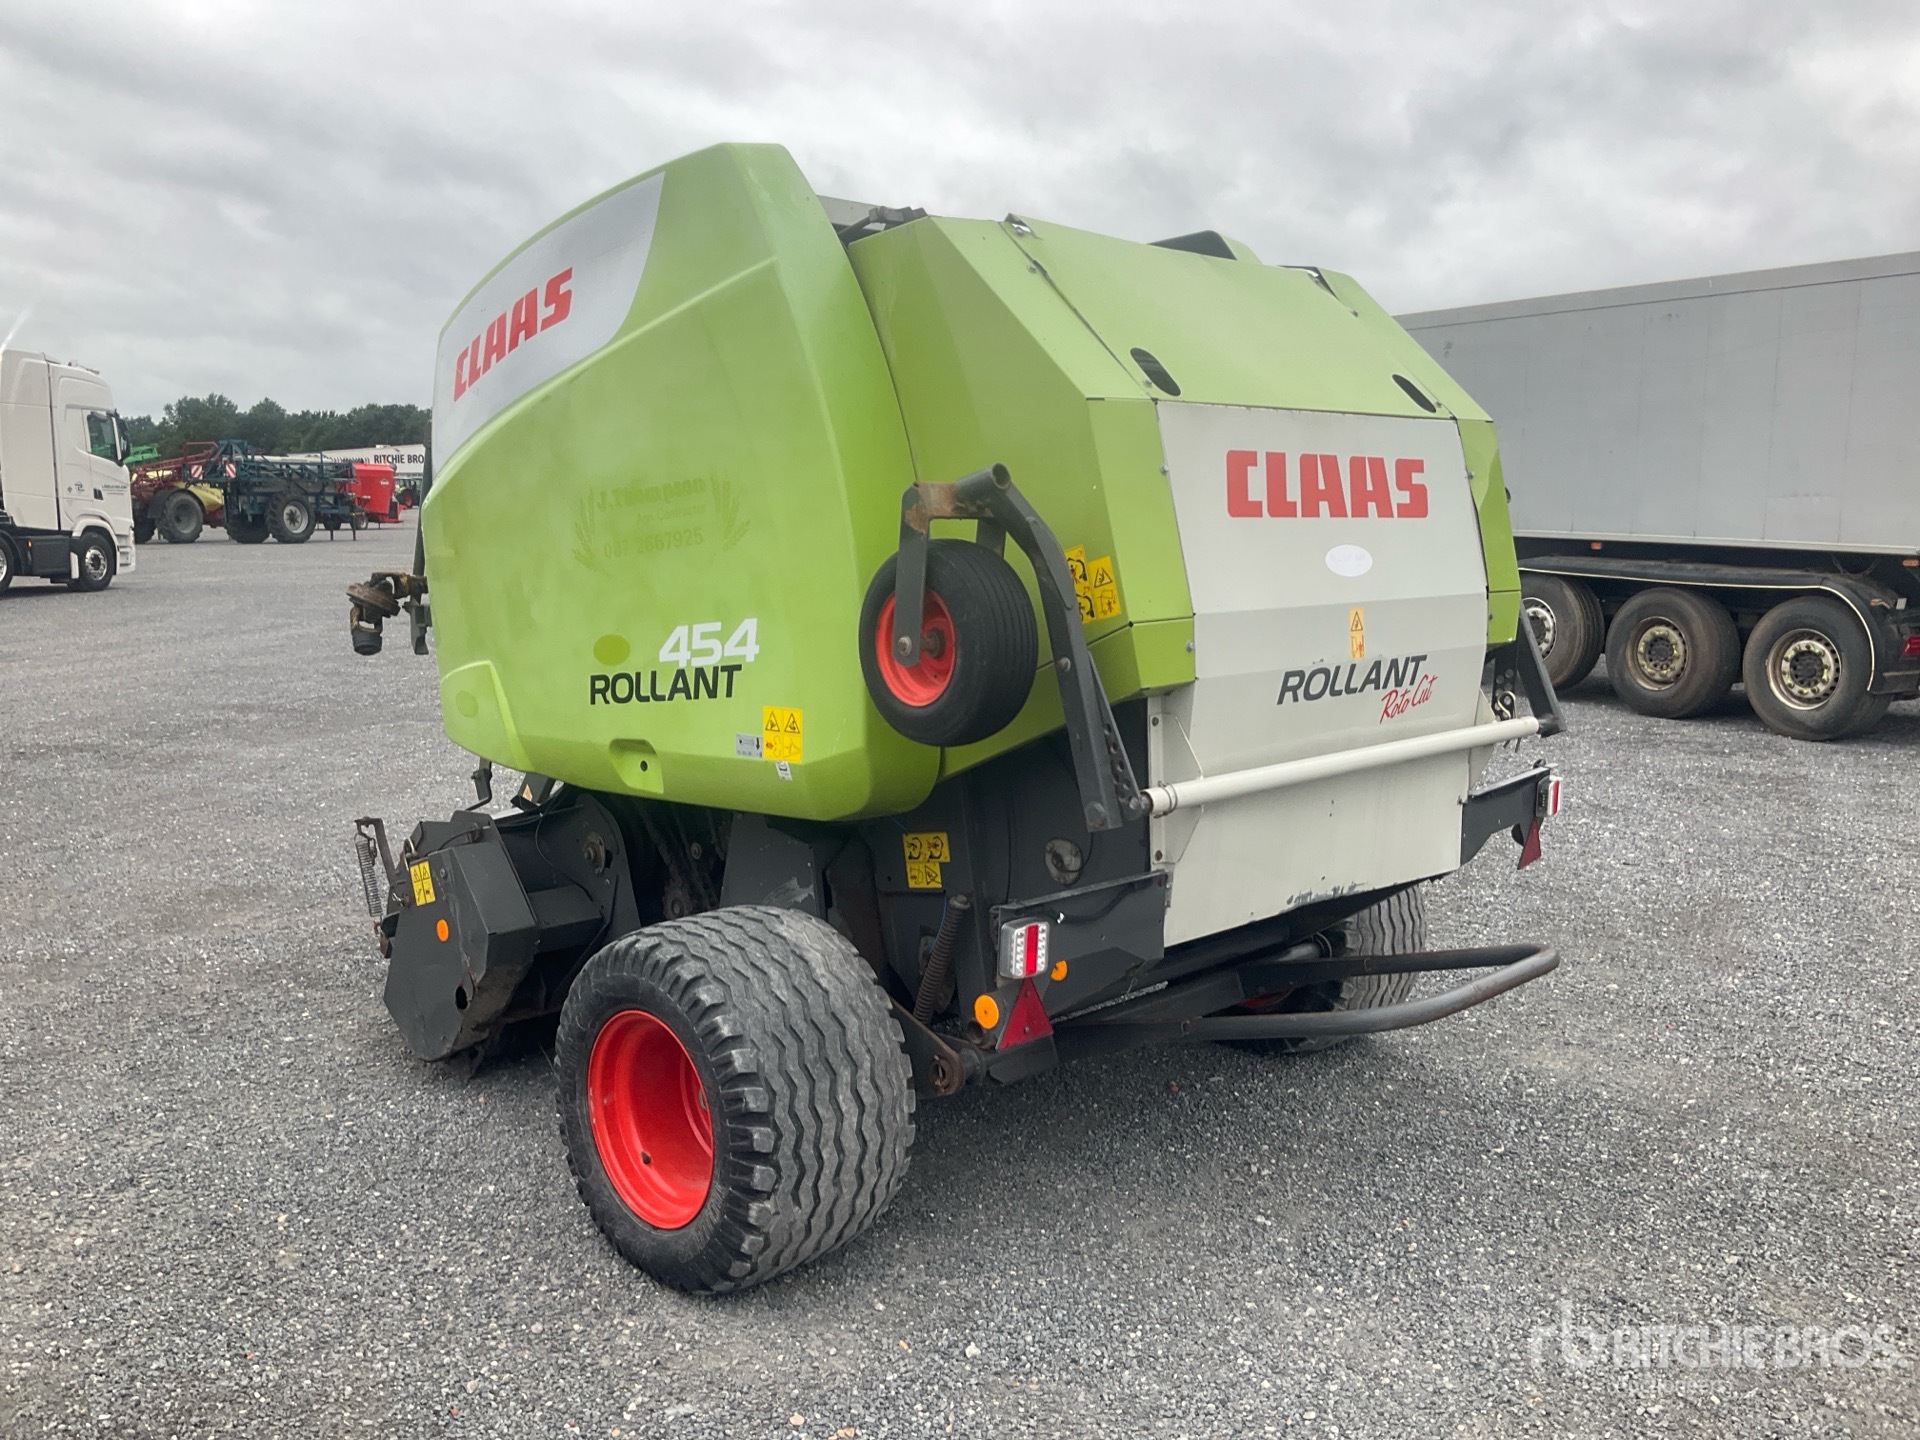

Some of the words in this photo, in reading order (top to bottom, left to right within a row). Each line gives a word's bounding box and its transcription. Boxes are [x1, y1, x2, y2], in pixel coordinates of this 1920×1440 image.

[453, 266, 573, 402] CLAAS
[373, 454, 405, 464] RITCHIE
[1226, 449, 1429, 519] CLAAS
[659, 617, 759, 667] 454
[590, 664, 742, 705] ROLLANT
[1277, 654, 1428, 706] ROLLANT
